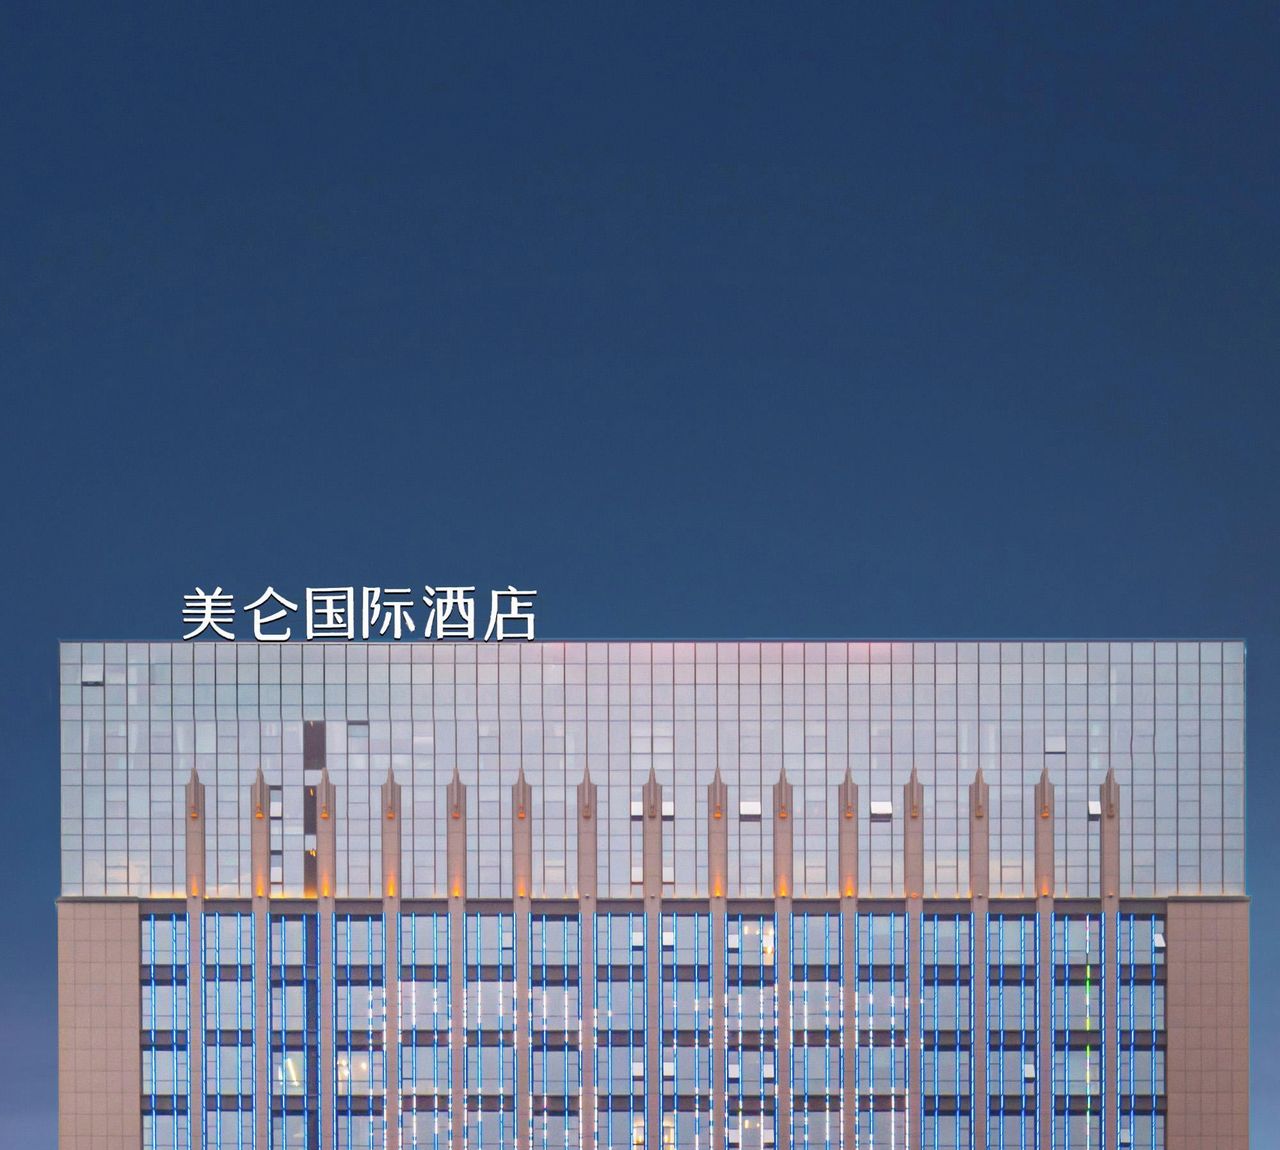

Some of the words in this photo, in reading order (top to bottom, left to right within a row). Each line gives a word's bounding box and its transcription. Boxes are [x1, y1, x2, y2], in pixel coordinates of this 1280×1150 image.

[182, 585, 537, 642] 美仑国际酒店
